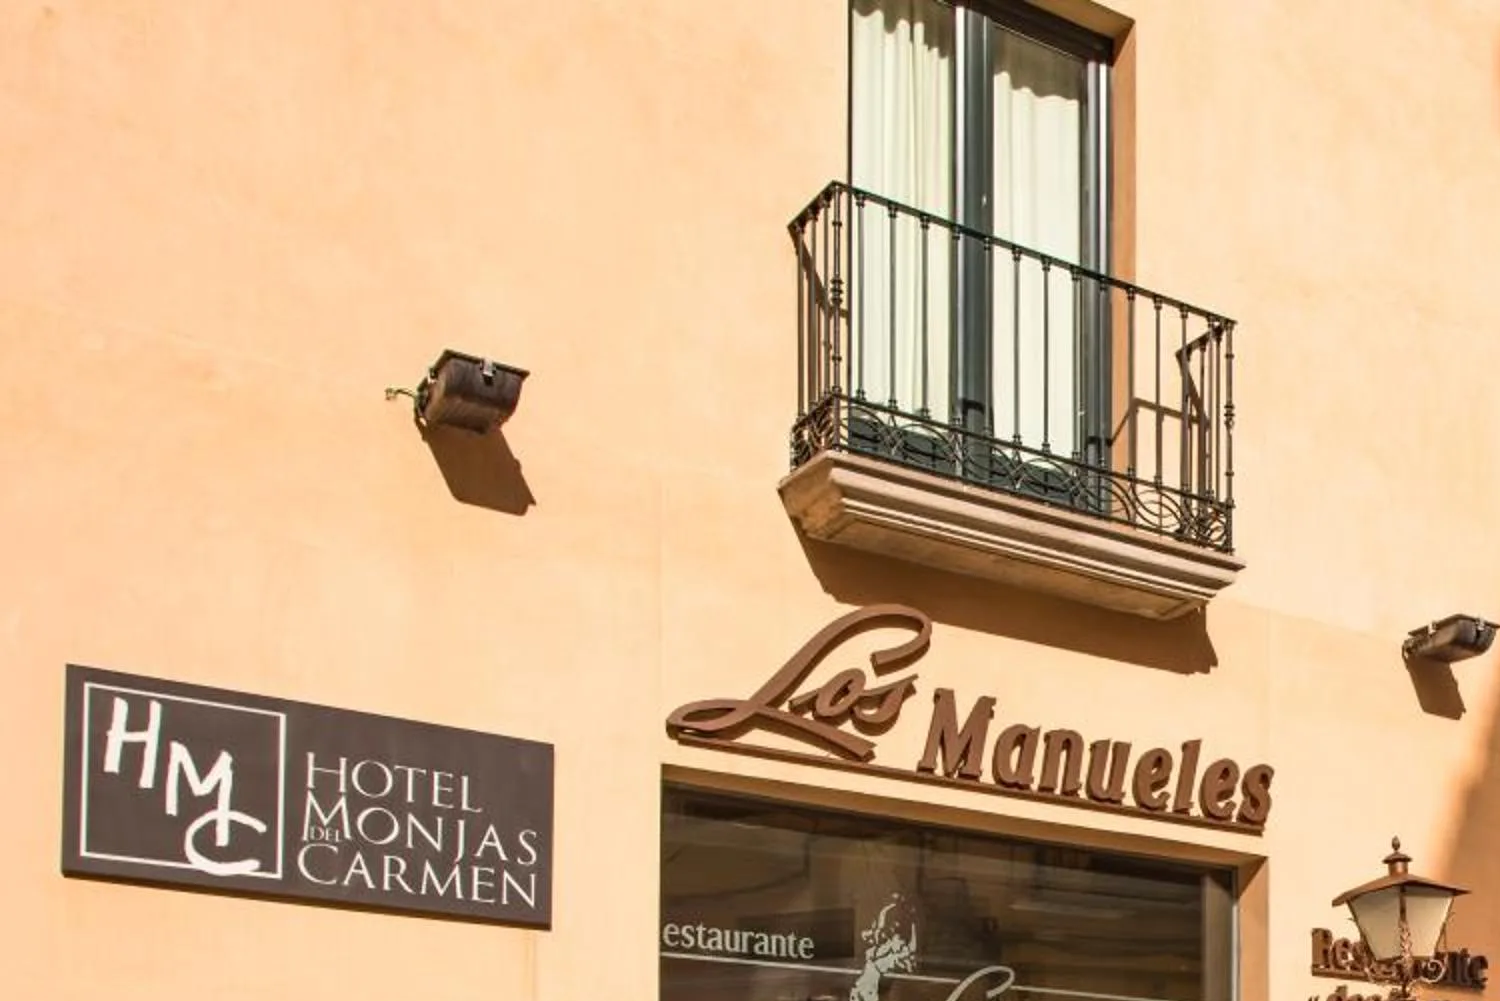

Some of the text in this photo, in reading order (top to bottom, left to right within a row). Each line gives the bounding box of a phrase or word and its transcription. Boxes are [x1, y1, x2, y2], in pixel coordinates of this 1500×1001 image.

[666, 603, 1274, 824] Los Manueles
[306, 752, 483, 813] HOTEL
[302, 790, 537, 866] MONJAS
[310, 825, 342, 843] DEL
[298, 843, 536, 908] CARMEN
[660, 921, 815, 960] estaurante
